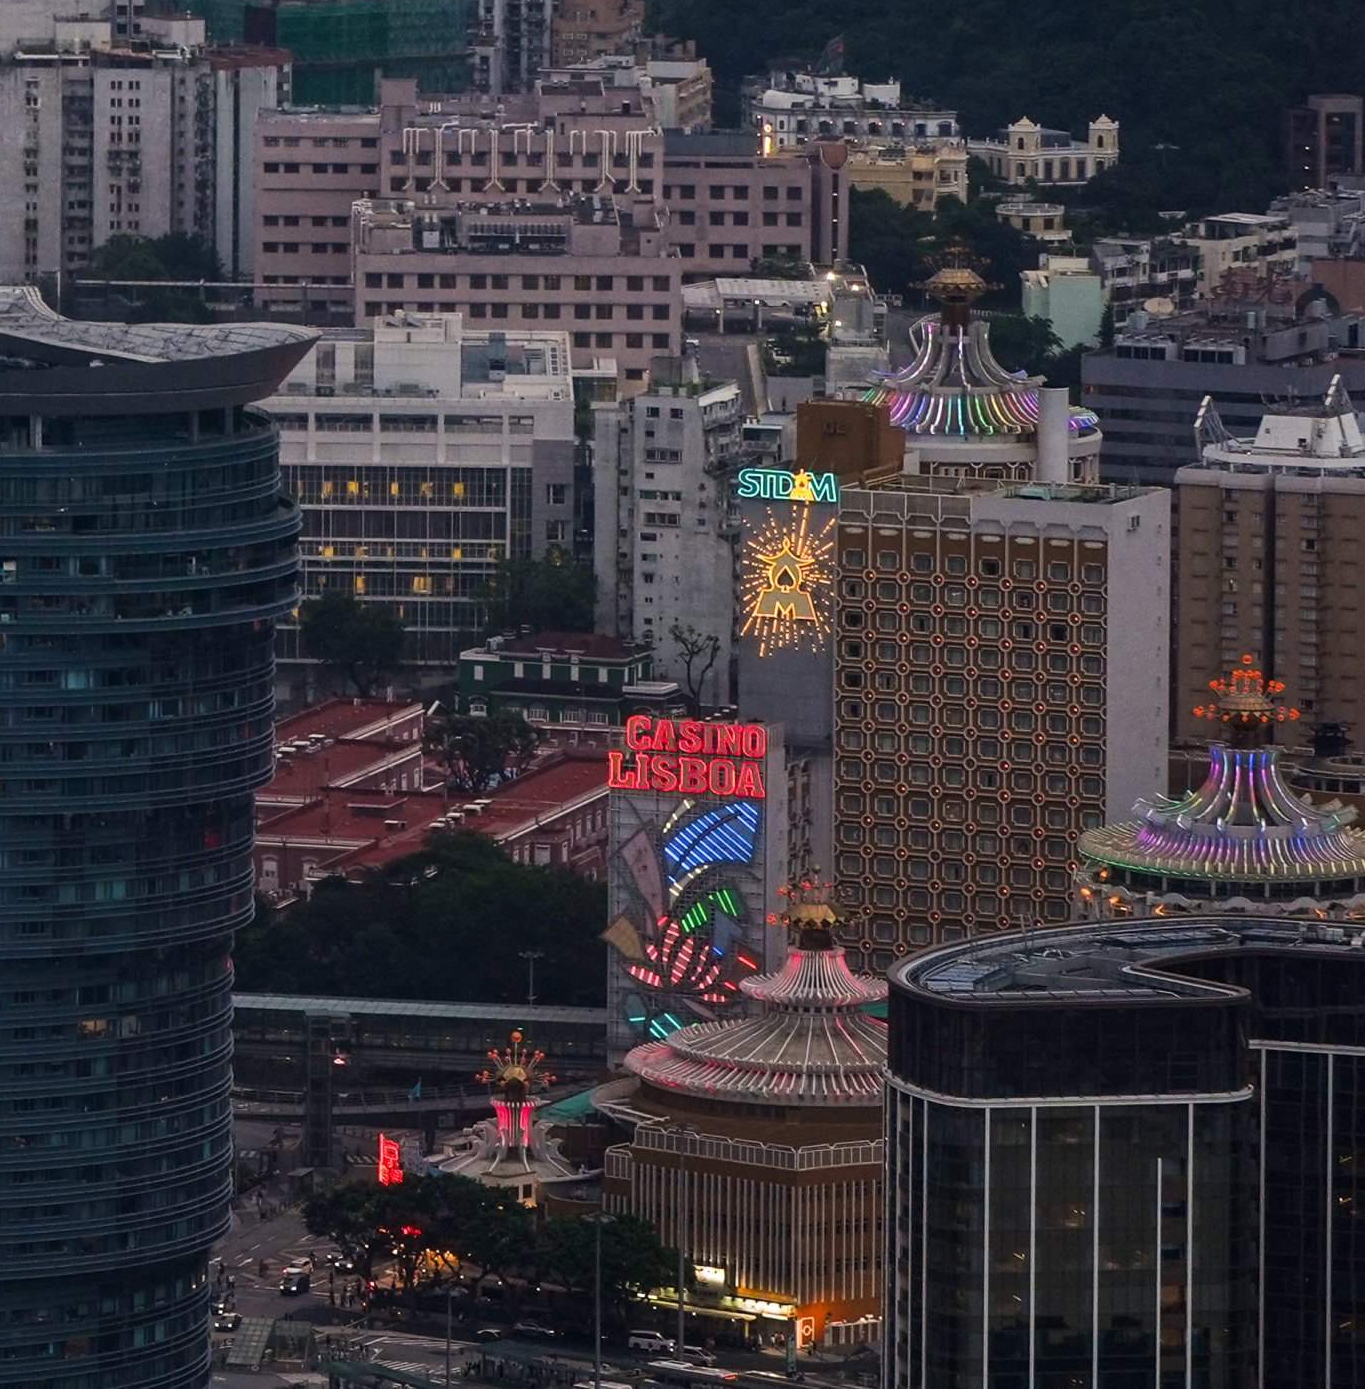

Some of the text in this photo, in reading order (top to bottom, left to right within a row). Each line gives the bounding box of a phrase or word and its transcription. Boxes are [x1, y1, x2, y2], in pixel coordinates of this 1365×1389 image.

[738, 468, 837, 503] STDM
[626, 715, 767, 759] CASINO
[608, 751, 766, 798] LISBOA
